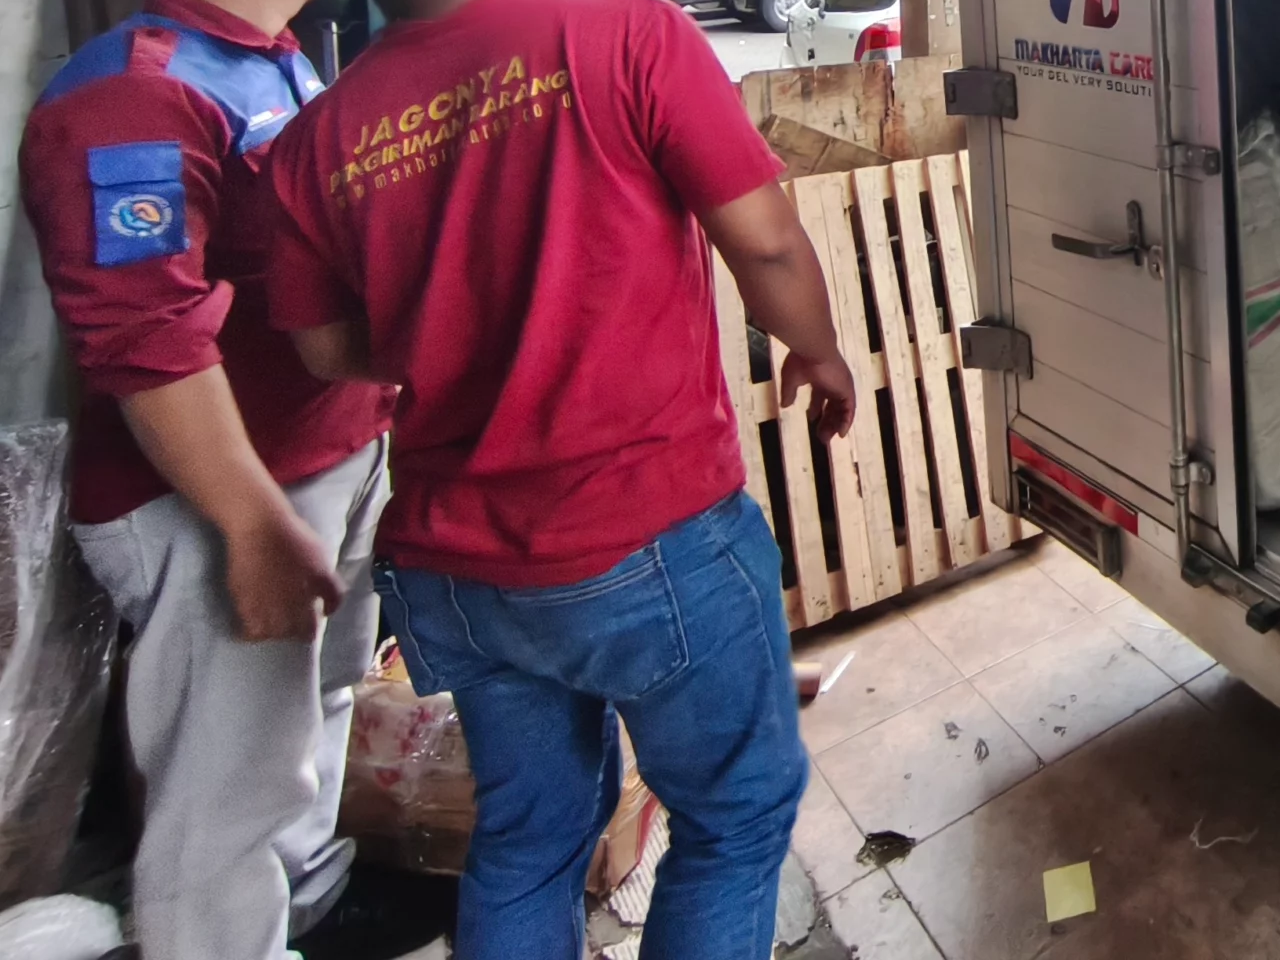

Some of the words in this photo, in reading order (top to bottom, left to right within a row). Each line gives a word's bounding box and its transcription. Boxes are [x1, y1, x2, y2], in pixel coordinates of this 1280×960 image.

[1014, 38, 1105, 73] MAKHARTA
[1016, 65, 1044, 79] YOUR
[1106, 80, 1152, 97] SOLUTI
[353, 55, 525, 155] JAGONYA
[330, 118, 467, 193] PNGIRIMAN
